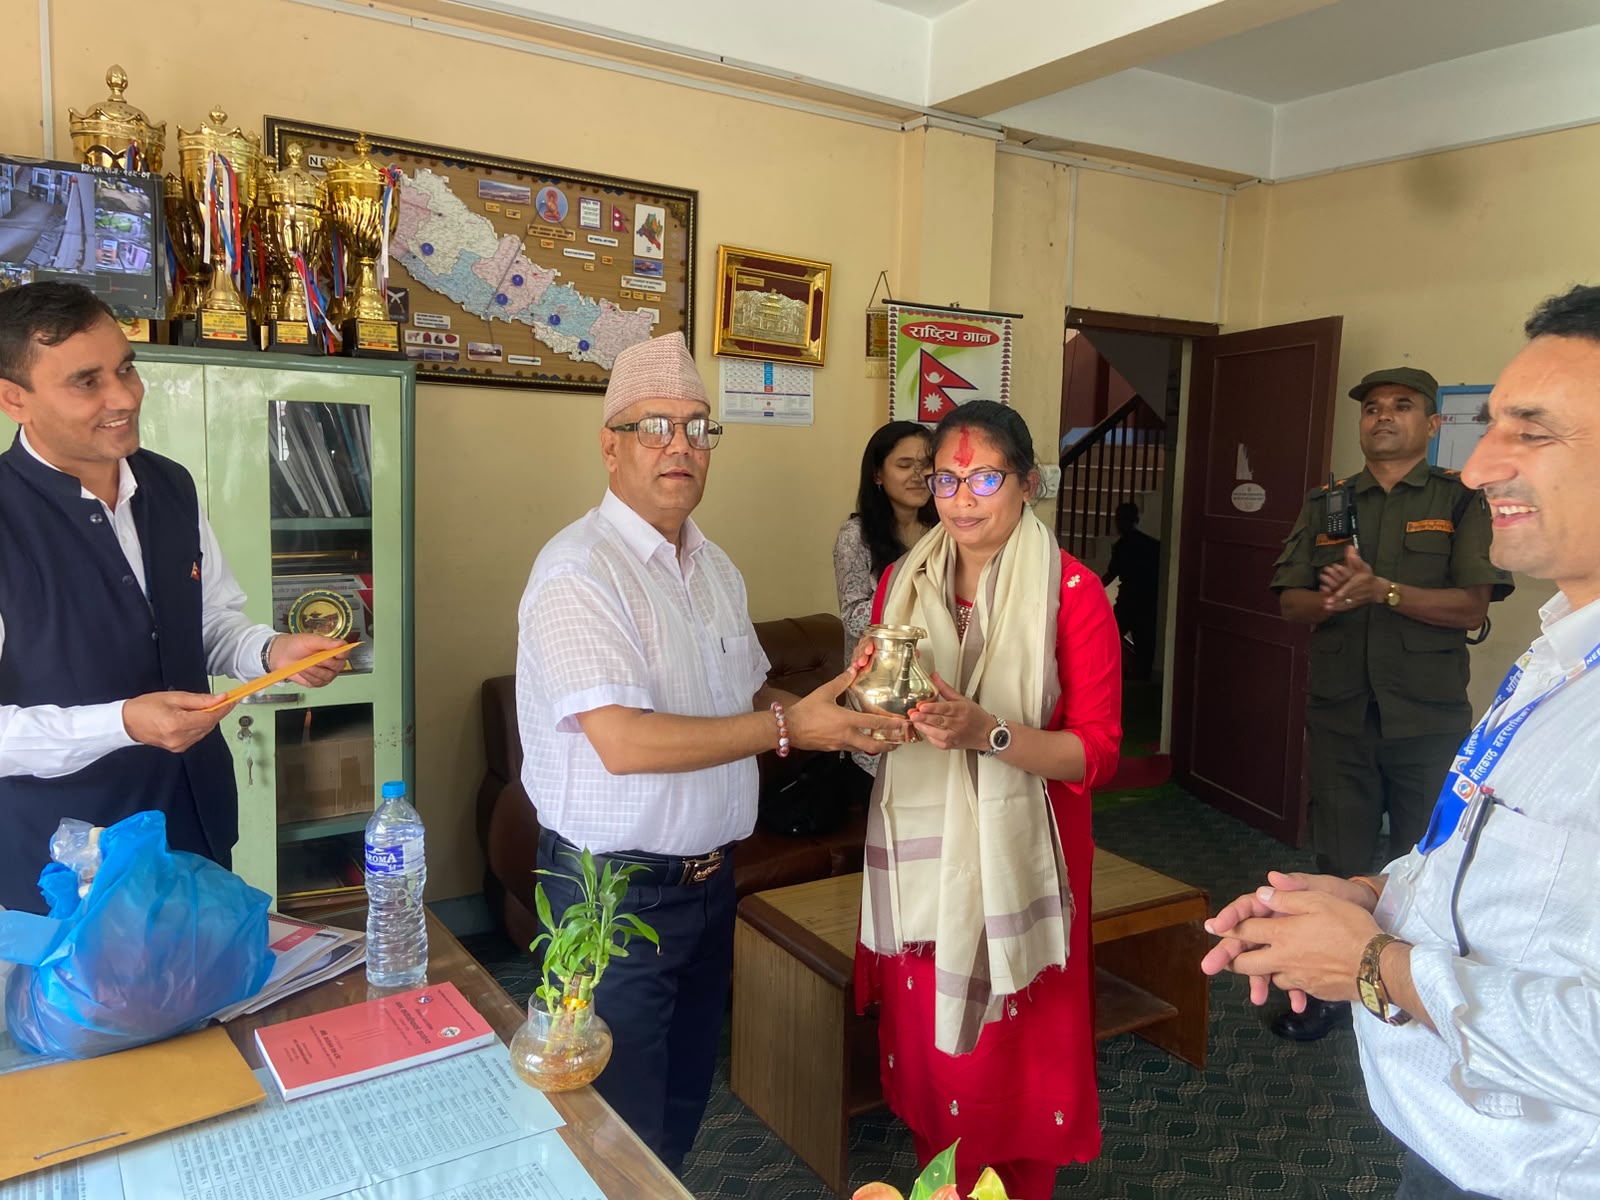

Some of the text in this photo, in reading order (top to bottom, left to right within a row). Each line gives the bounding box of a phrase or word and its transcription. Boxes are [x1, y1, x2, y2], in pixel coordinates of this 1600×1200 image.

[909, 324, 992, 344] राष्ट्रिय गान
[1469, 747, 1499, 781] नीलकण्ठ
